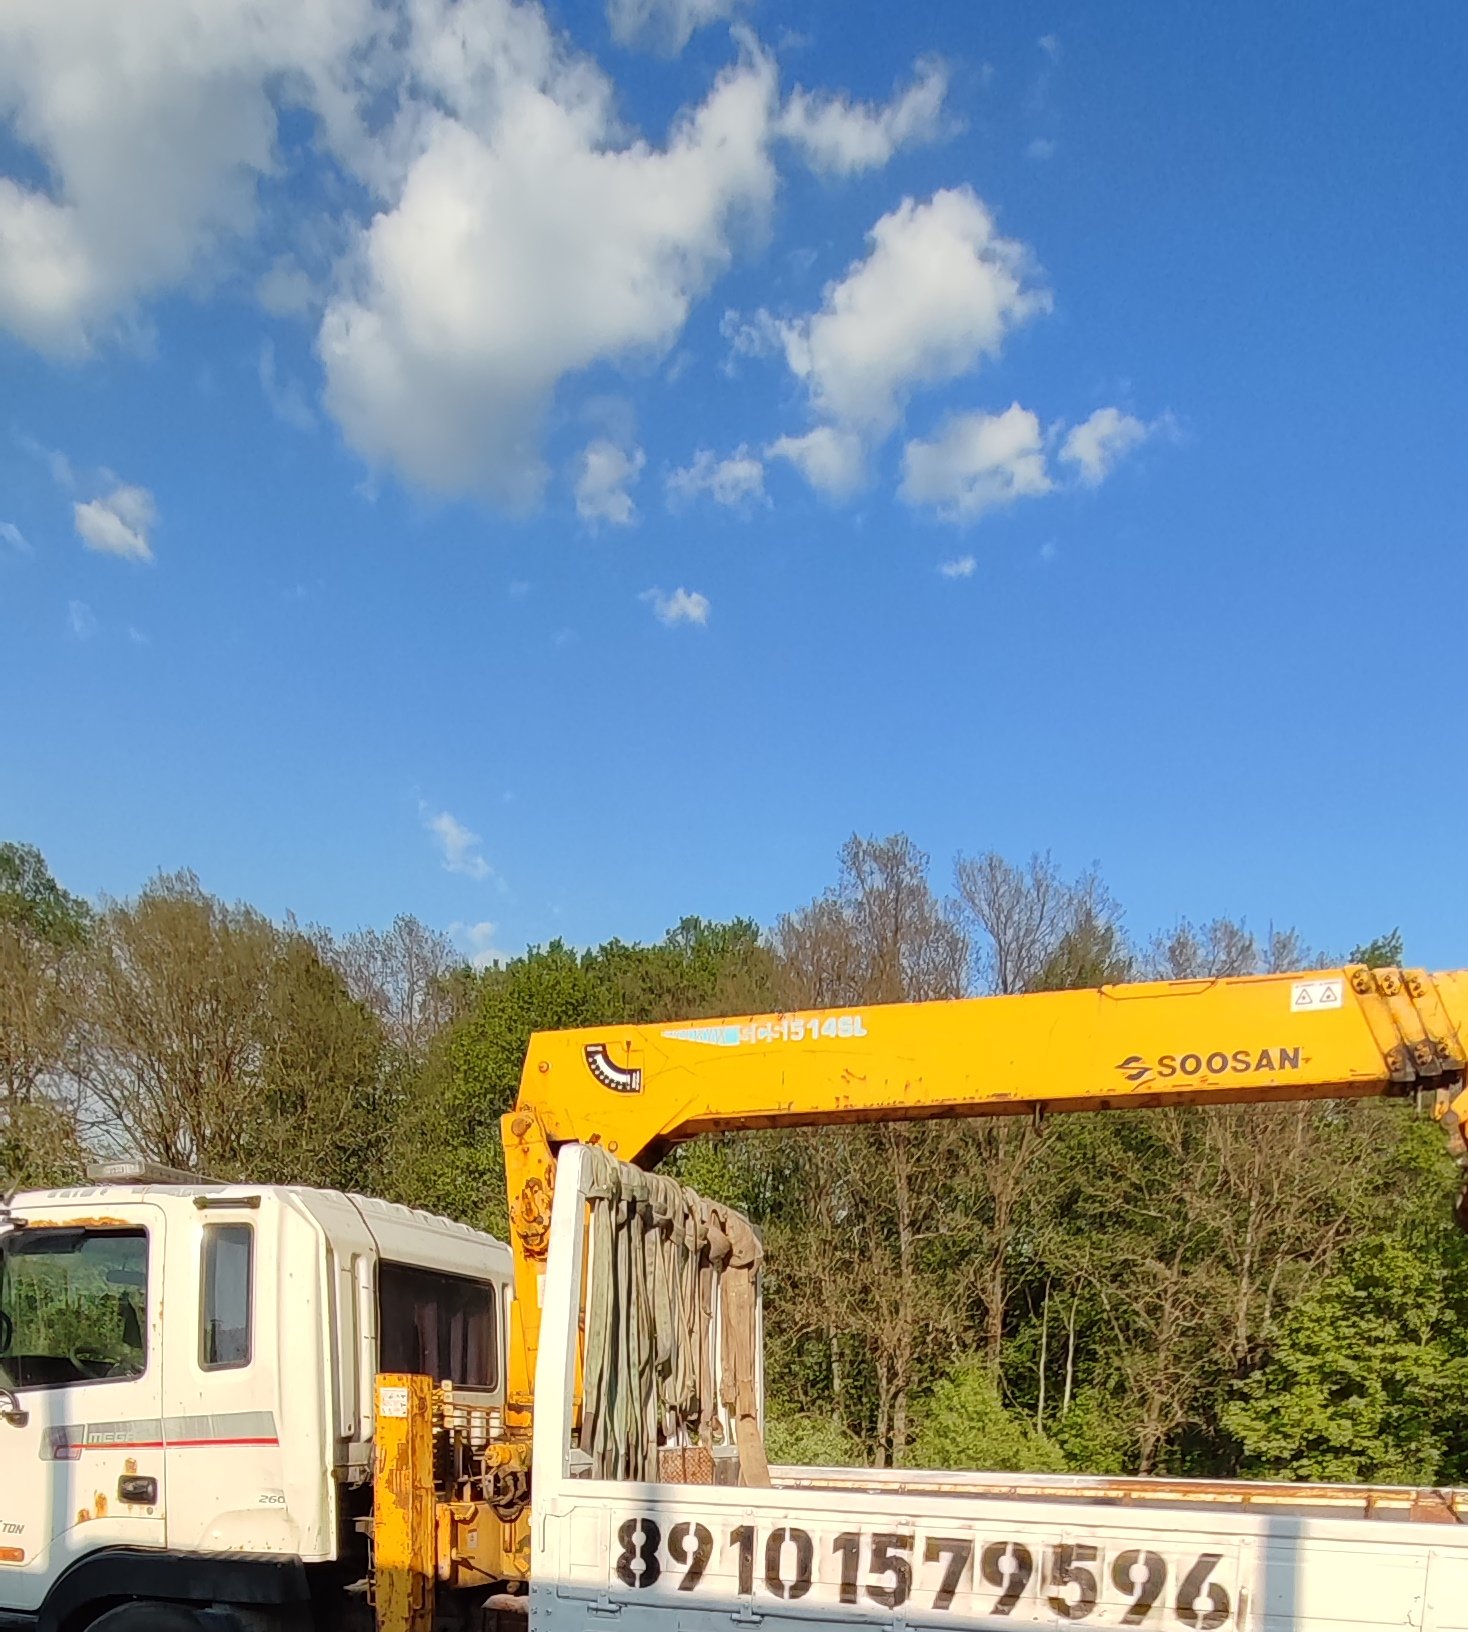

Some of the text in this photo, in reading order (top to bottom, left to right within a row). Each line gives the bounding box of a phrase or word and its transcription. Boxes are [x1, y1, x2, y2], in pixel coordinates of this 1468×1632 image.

[1157, 1047, 1300, 1078] SOOSAN
[258, 1494, 286, 1504] 260
[2, 1522, 25, 1535] TON
